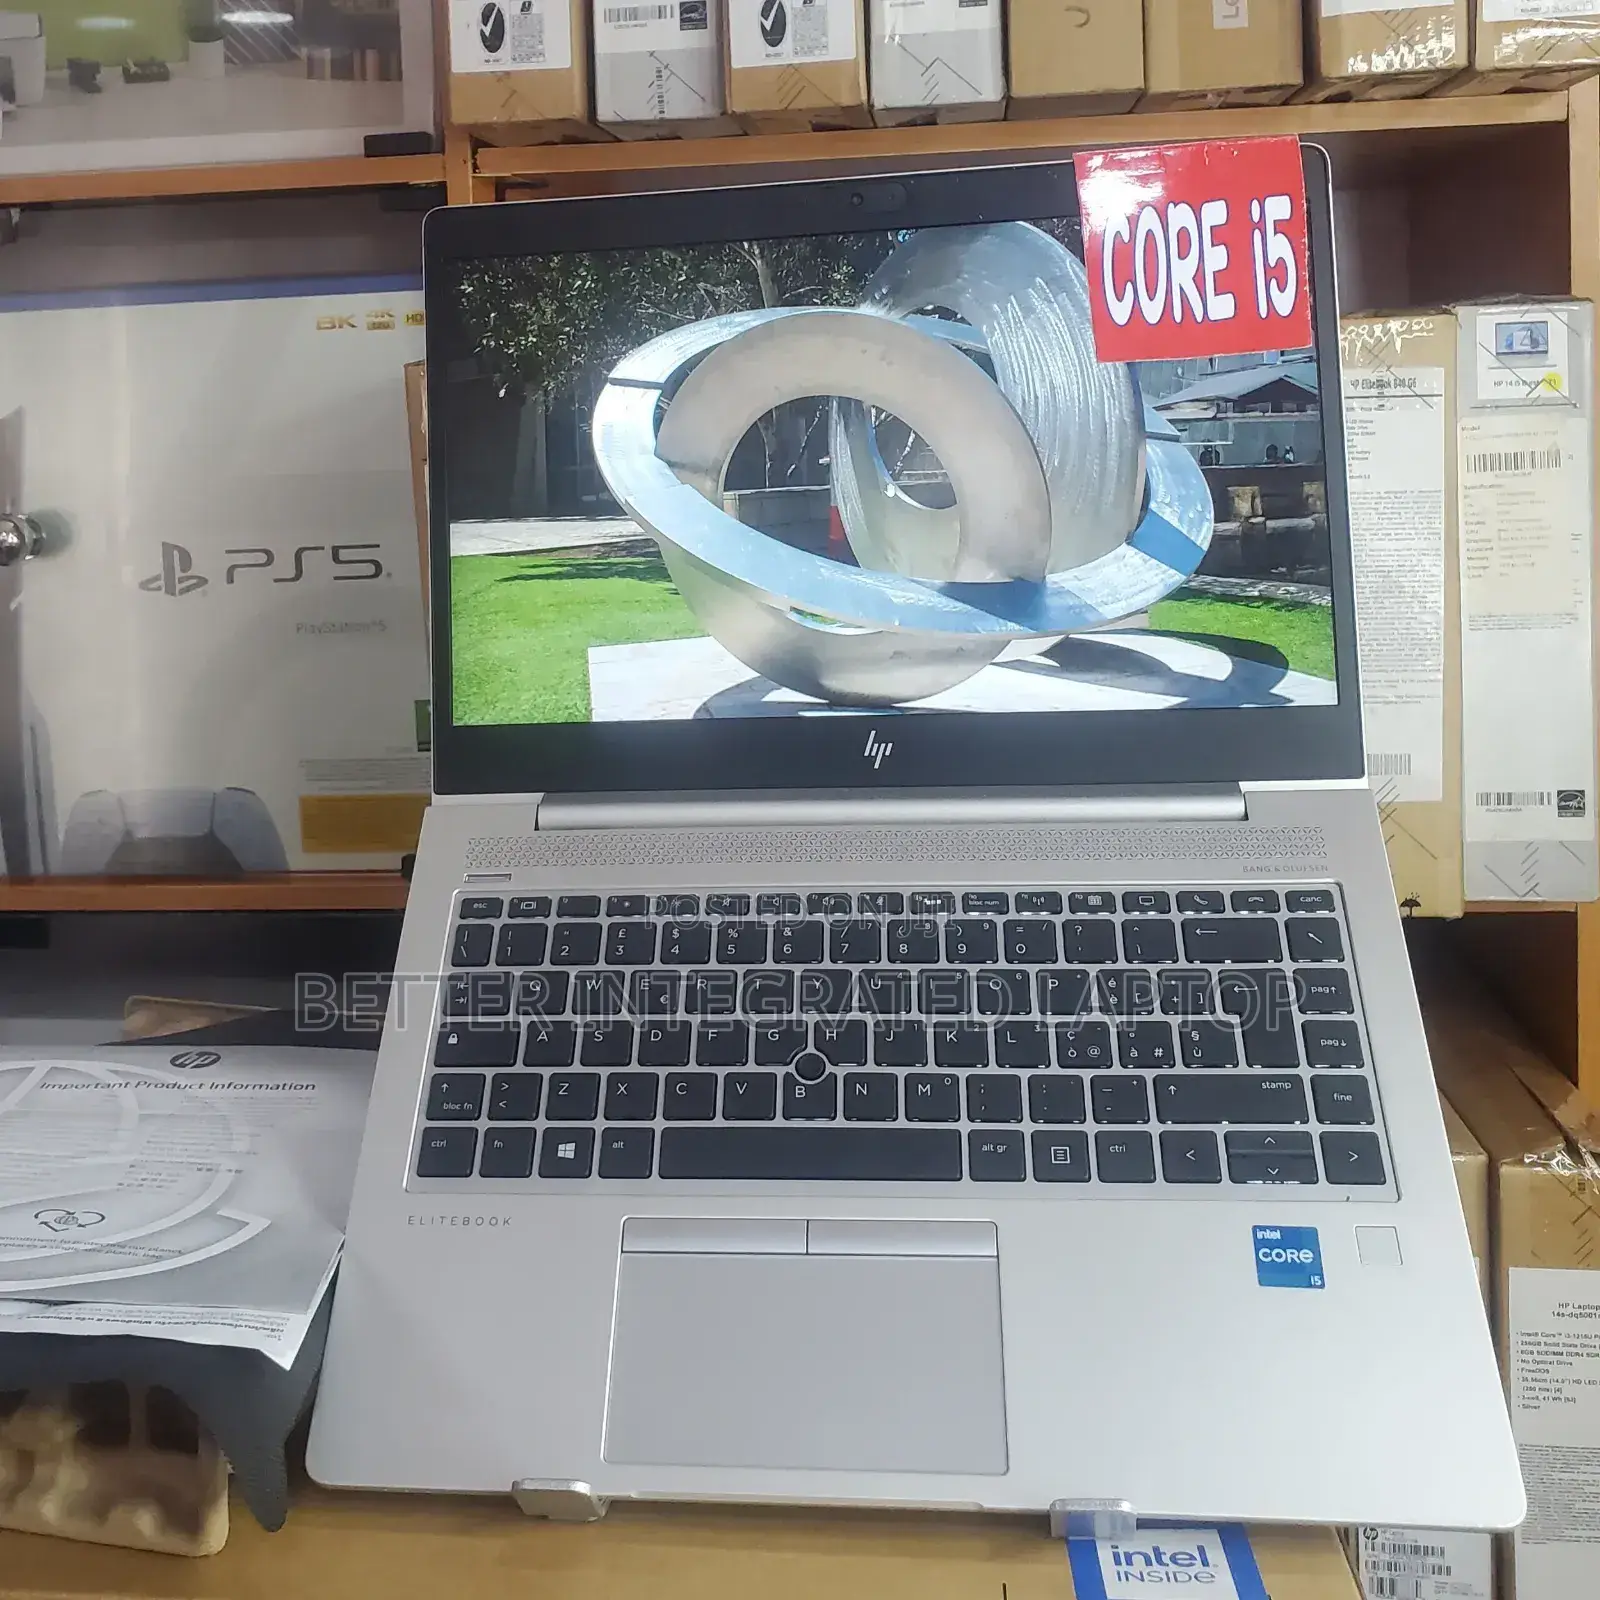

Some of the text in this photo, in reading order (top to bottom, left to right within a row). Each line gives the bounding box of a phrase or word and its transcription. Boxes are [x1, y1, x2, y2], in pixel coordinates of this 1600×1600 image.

[1102, 194, 1298, 327] CORE i5
[316, 313, 358, 331] 8K
[1407, 377, 1417, 389] G6
[1493, 379, 1503, 387] HP
[1505, 379, 1513, 387] 14
[225, 543, 383, 585] PS5
[864, 730, 893, 769] hp
[1242, 865, 1271, 873] BANG
[1283, 864, 1329, 872] OLUFSEN
[618, 929, 626, 938] £
[672, 928, 680, 939] $
[728, 929, 738, 938] %
[783, 927, 792, 936] &
[1075, 926, 1082, 935] ?
[507, 947, 511, 956] 1
[561, 946, 569, 956] 2
[616, 945, 624, 955] 3
[671, 945, 680, 955] 4
[727, 945, 735, 955] 5
[784, 944, 792, 954] 6
[841, 944, 849, 954] 7
[899, 944, 908, 953] 8
[958, 944, 966, 954] 9
[1016, 944, 1025, 953] 0
[530, 980, 541, 991] Q
[586, 979, 602, 990] W
[641, 979, 649, 990] E
[698, 979, 707, 989] R
[754, 979, 762, 990] T
[813, 978, 823, 989] Y
[871, 978, 880, 989] U
[990, 978, 1001, 990] O
[1049, 979, 1058, 990] P
[1311, 985, 1329, 995] pag
[536, 1030, 548, 1041] A
[594, 1030, 603, 1041] S
[651, 1030, 662, 1041] D
[708, 1030, 718, 1041] F
[767, 1030, 779, 1041] G
[826, 1030, 837, 1041] H
[885, 1030, 893, 1041] J
[947, 1030, 957, 1042] K
[1007, 1030, 1016, 1043] L
[1321, 1038, 1339, 1048] pag
[1087, 1046, 1100, 1057] @
[1154, 1047, 1164, 1058] #
[170, 1051, 221, 1069] hp
[40, 1080, 317, 1092] Important Product Information
[558, 1084, 569, 1095] Z
[617, 1083, 628, 1095] X
[676, 1083, 687, 1095] C
[736, 1083, 747, 1095] V
[856, 1084, 867, 1095] N
[918, 1084, 931, 1096] M
[1261, 1080, 1291, 1091] stamp
[795, 1087, 805, 1098] B
[1334, 1092, 1352, 1102] fine
[443, 1102, 473, 1110] bloc fn
[431, 1139, 447, 1148] ctrl
[494, 1140, 503, 1148] fn
[612, 1140, 624, 1149] alt
[982, 1143, 1007, 1153] alt gr
[1109, 1143, 1126, 1152] ctrl
[407, 1215, 512, 1226] ELITEBOOK
[1257, 1229, 1281, 1240] intel
[1310, 1275, 1322, 1286] i5
[1363, 1526, 1379, 1540] hp
[1110, 1544, 1210, 1568] intel
